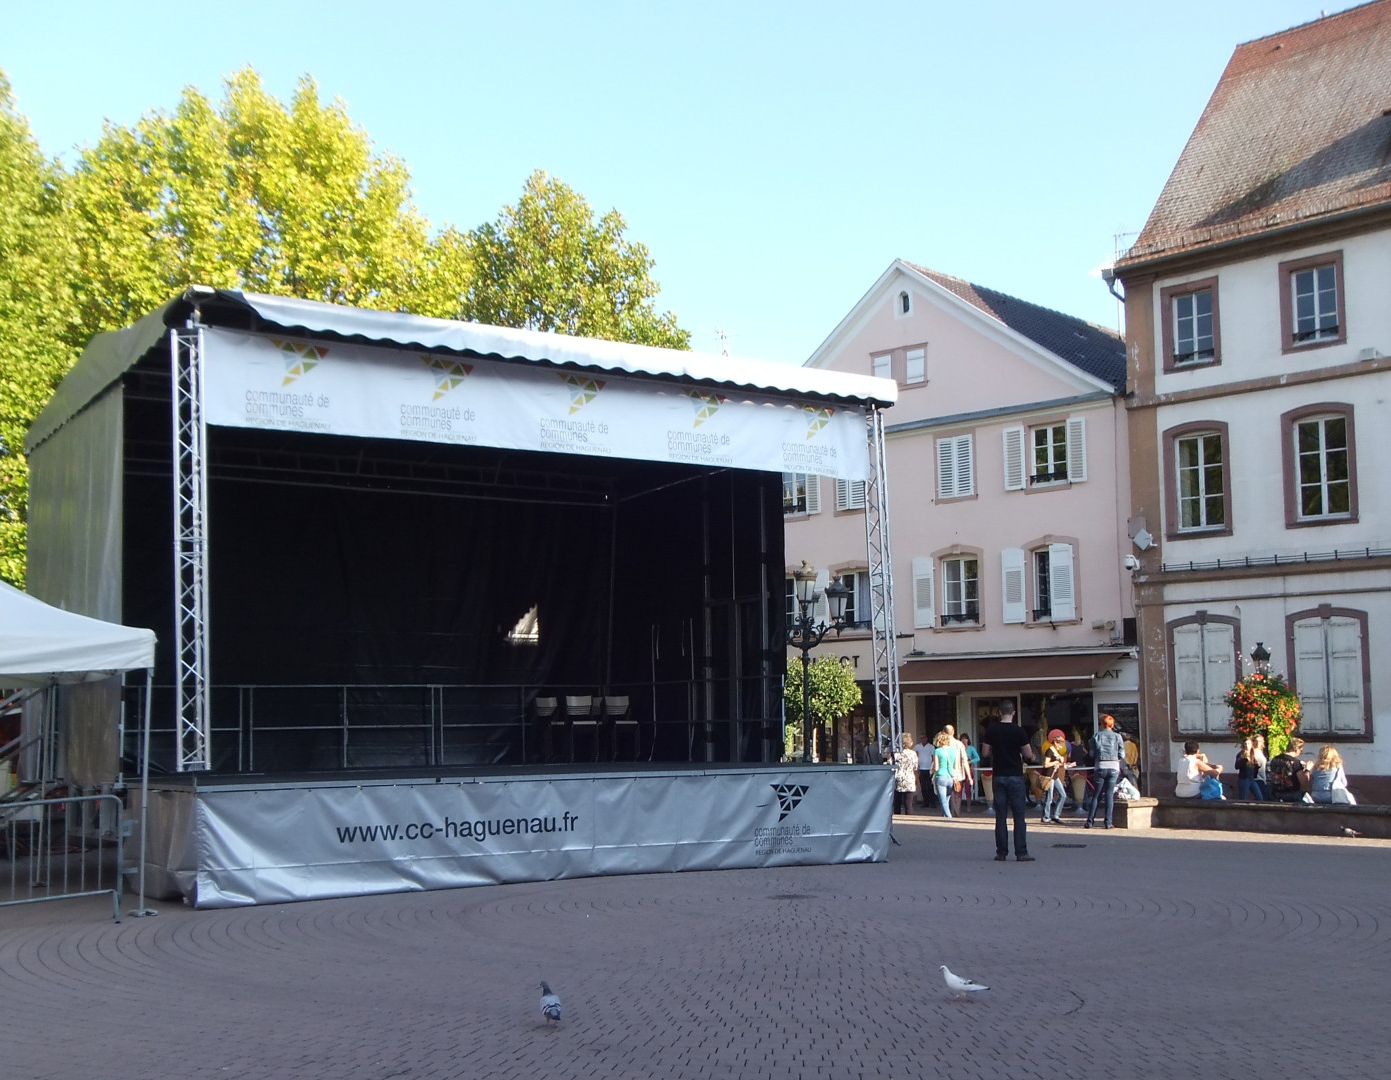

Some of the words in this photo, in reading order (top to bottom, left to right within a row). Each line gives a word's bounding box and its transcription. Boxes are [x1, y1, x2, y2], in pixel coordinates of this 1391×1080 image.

[245, 389, 314, 407] communauté
[317, 393, 330, 408] de
[245, 401, 304, 418] communes
[400, 403, 461, 420] communauté
[464, 408, 475, 421] de
[400, 415, 452, 431] communes
[540, 417, 595, 433] communauté
[598, 422, 609, 435] de
[540, 428, 588, 443] communes
[336, 811, 579, 843] www.cc-haguenau.fr
[754, 825, 800, 837] communauté
[802, 824, 810, 835] de
[754, 836, 793, 847] communes
